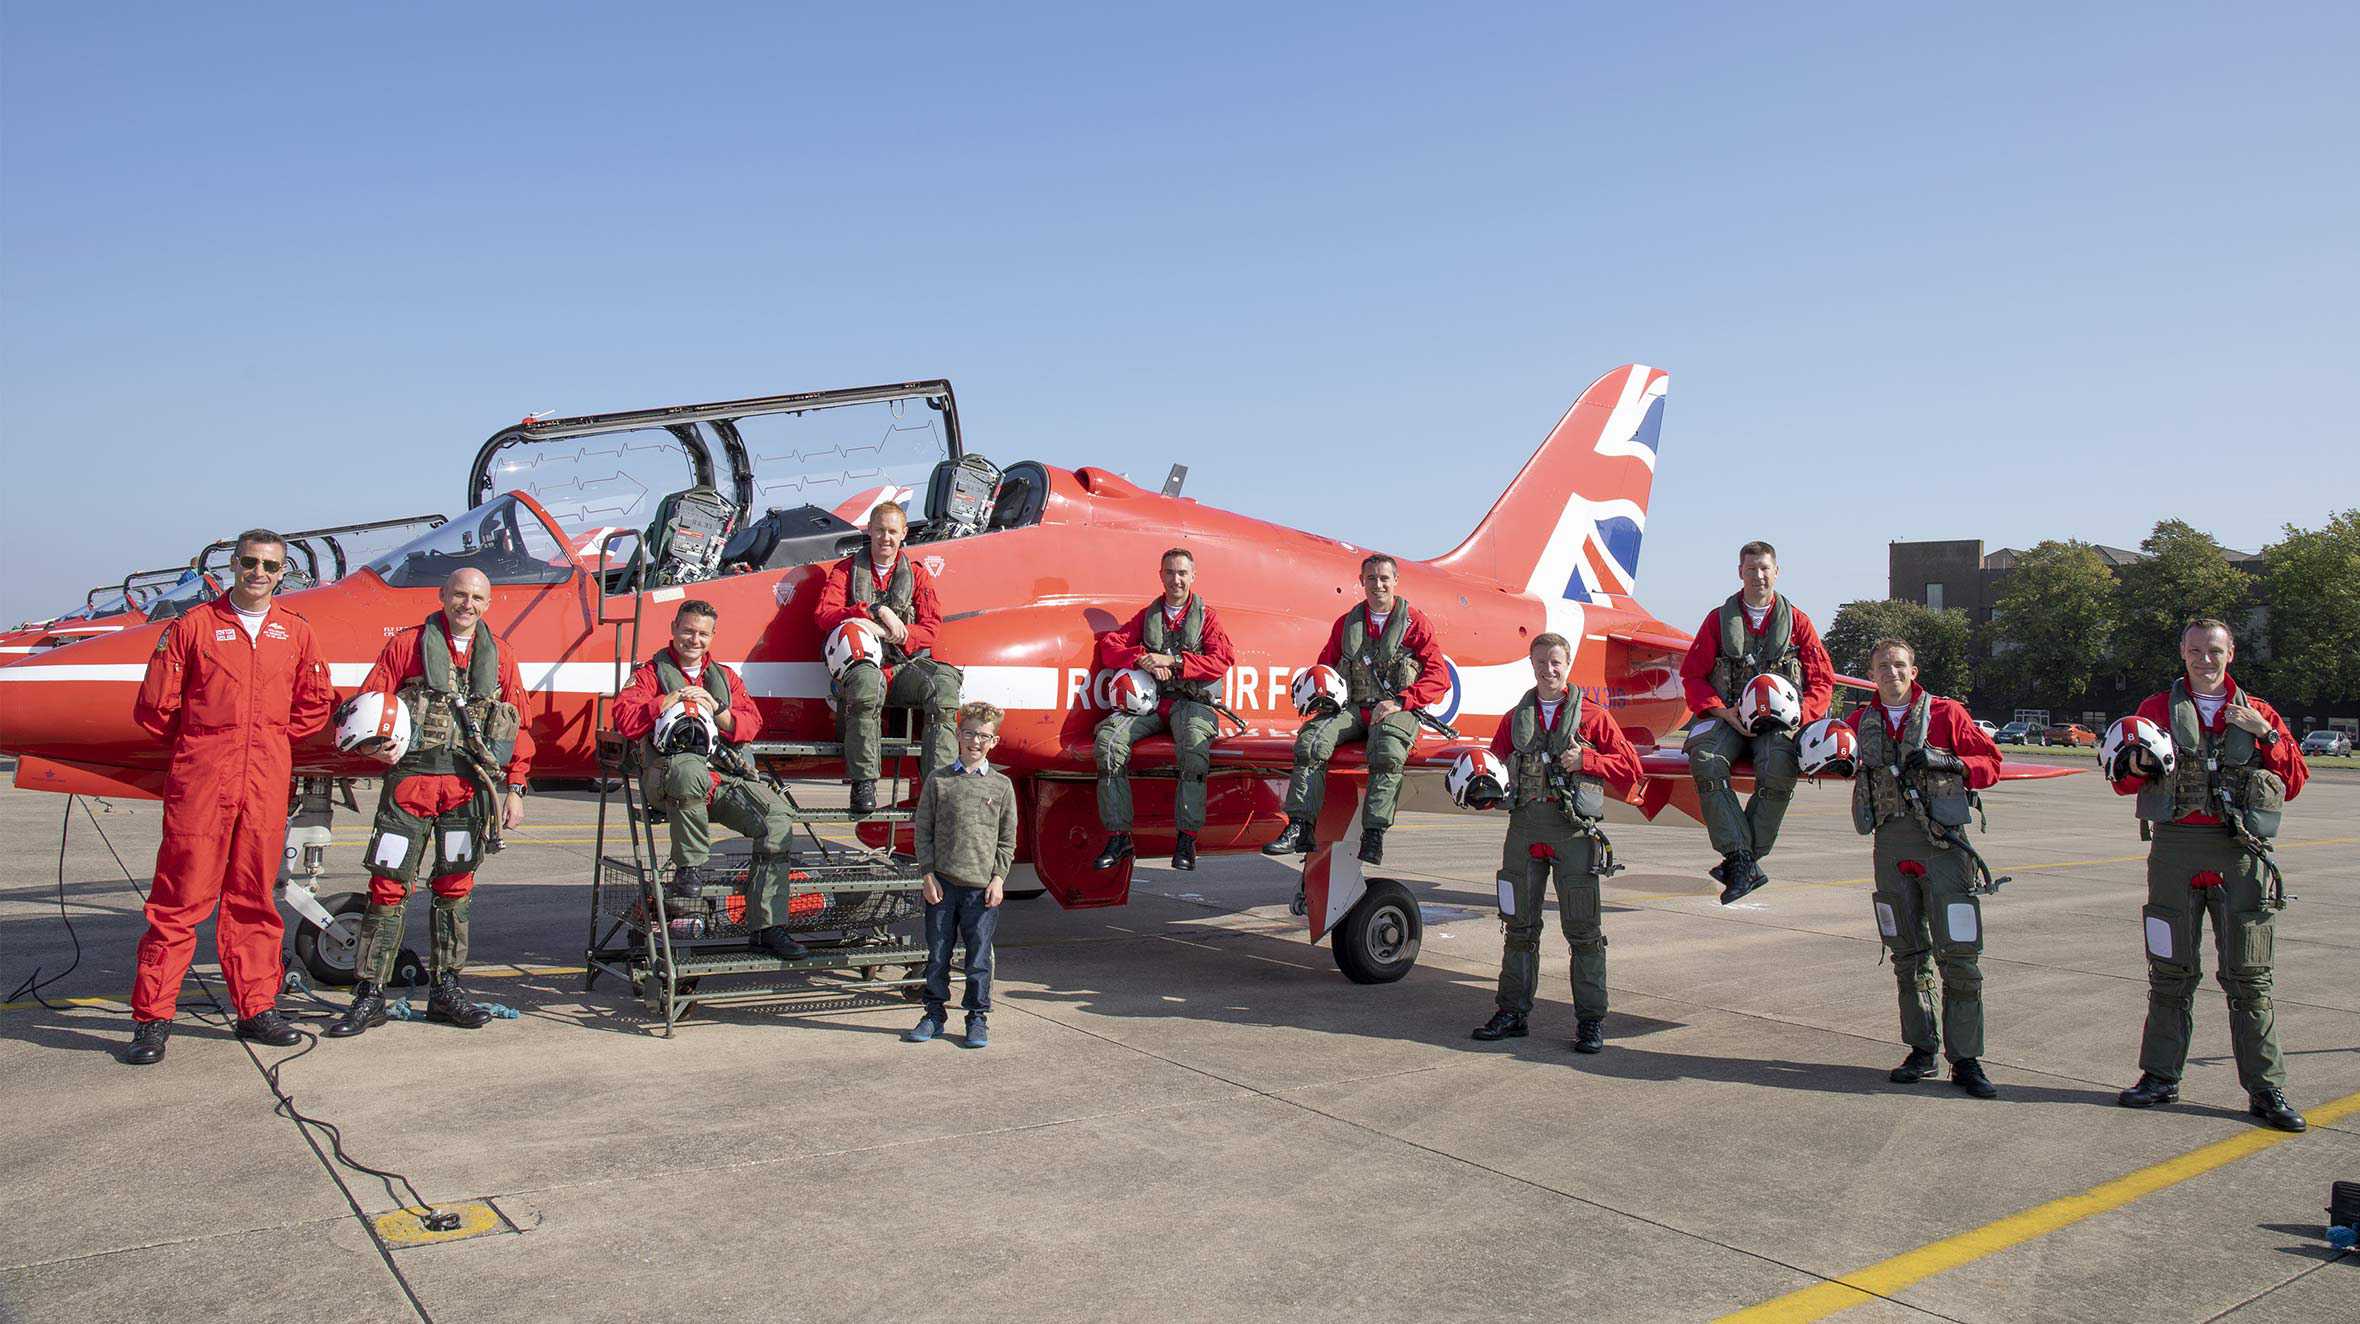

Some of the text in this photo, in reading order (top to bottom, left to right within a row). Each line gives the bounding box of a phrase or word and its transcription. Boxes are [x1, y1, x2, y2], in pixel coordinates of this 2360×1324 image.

[1760, 704, 1767, 712] 5
[383, 722, 391, 732] 9
[2127, 732, 2135, 741] 8
[1840, 747, 1847, 756] 6
[1477, 764, 1483, 772] 7
